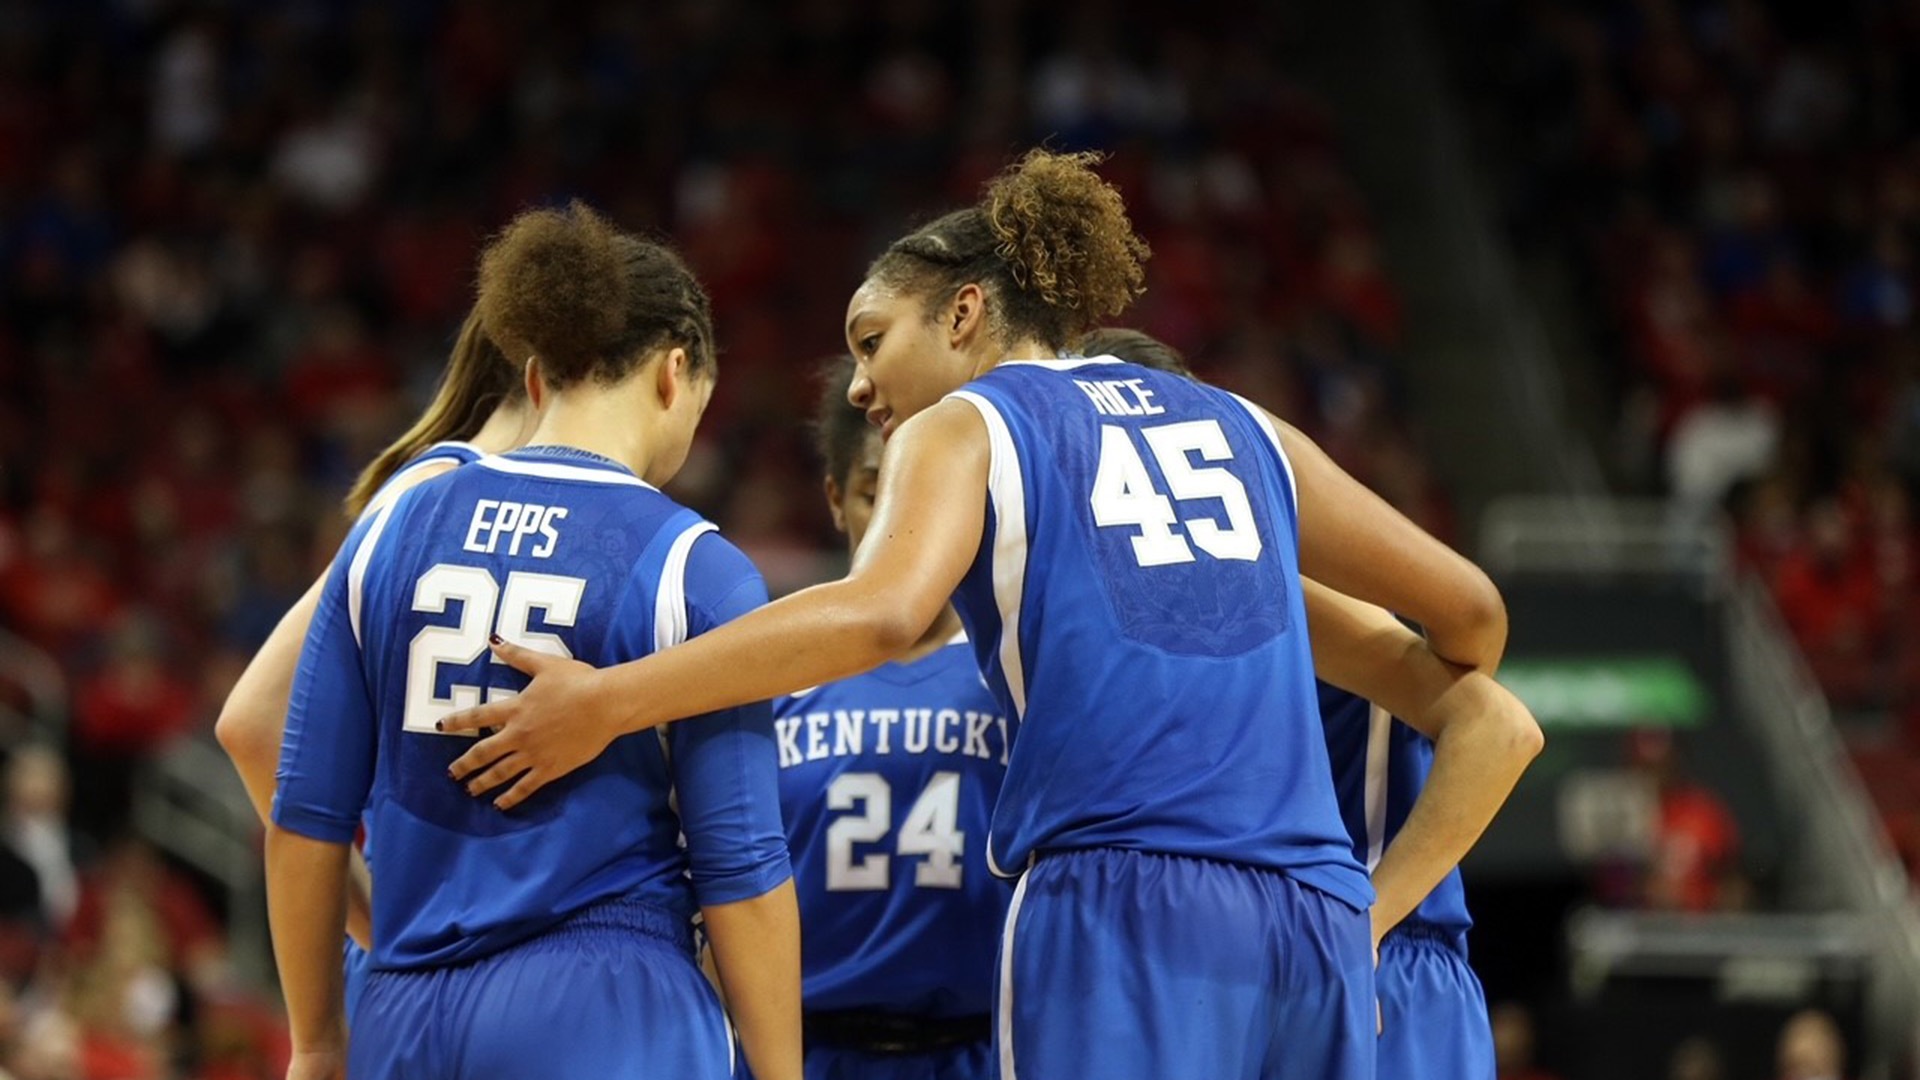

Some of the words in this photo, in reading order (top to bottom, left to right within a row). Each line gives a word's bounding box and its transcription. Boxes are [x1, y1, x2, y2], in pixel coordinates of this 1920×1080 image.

[1073, 379, 1166, 416] RICE
[463, 499, 568, 558] EPPS
[1090, 419, 1262, 567] 45
[402, 563, 587, 737] 25
[826, 771, 964, 892] 24
